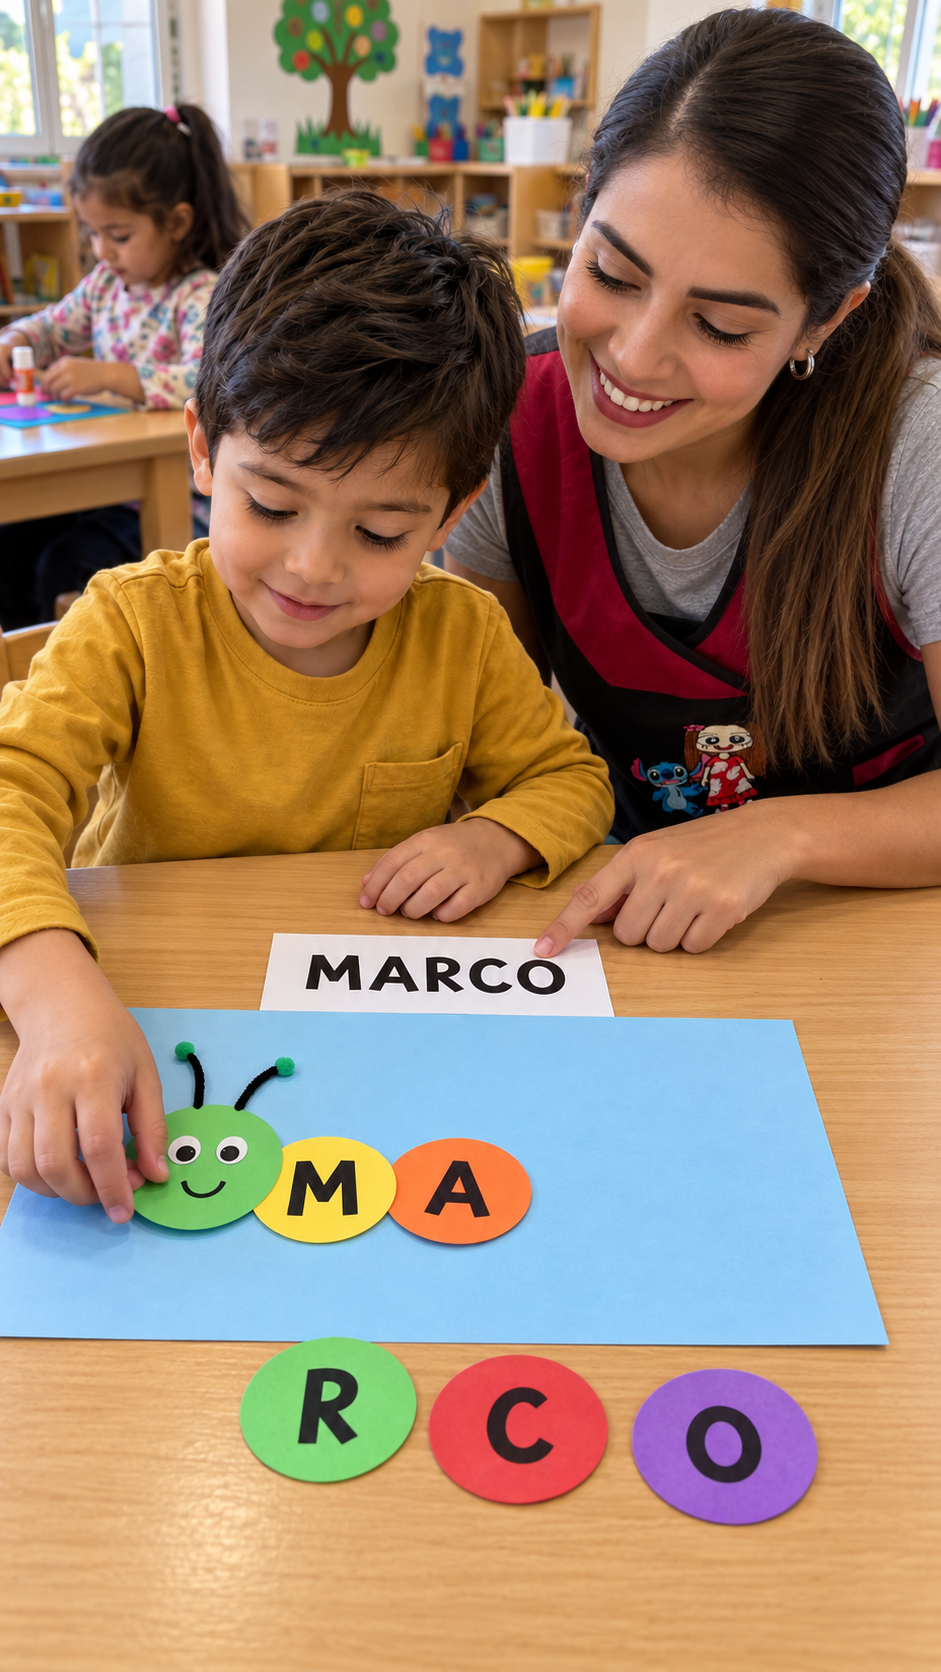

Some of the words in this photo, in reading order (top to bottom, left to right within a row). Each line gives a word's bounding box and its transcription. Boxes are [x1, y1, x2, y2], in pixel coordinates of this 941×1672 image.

[305, 954, 566, 995] MARCO
[287, 1160, 358, 1217] M
[424, 1160, 490, 1218] A
[298, 1368, 359, 1445] R
[486, 1387, 553, 1464] C
[686, 1405, 762, 1483] O
